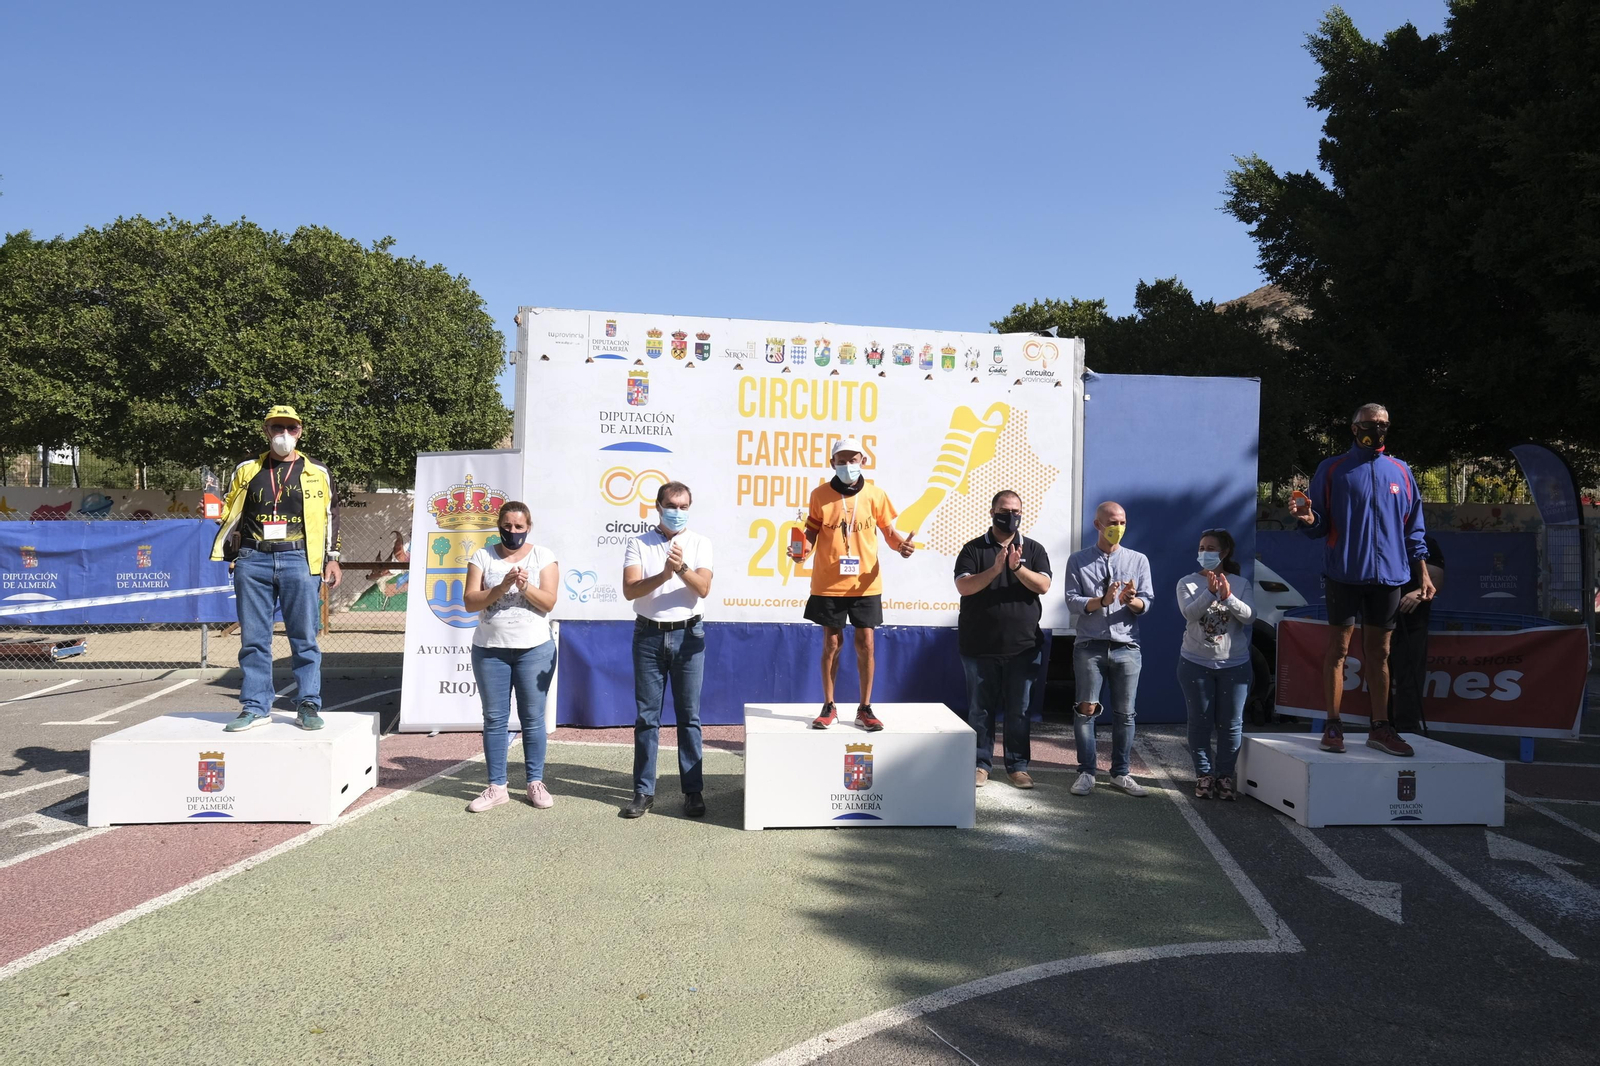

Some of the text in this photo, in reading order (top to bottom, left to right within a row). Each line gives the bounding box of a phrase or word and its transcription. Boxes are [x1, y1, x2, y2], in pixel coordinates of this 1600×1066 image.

[592, 338, 630, 346] DIPUTACIÓN
[1025, 368, 1055, 377] circuitos
[737, 375, 879, 423] CIRCUITO
[599, 410, 676, 424] DIPUTACIÓN
[600, 424, 674, 436] DE ALMERÍA
[844, 565, 856, 573] 233
[2, 571, 58, 581] DIPUTACIÓN
[116, 570, 171, 581] DIPUTACIÓN
[1479, 574, 1518, 582] DIPUTACIÓN
[3, 579, 57, 589] DE ALMERÍA
[117, 579, 170, 589] DE ALMERÍA
[1490, 581, 1517, 589] ALMERÍA
[593, 586, 617, 594] JUEGA
[1457, 655, 1469, 666] &
[1473, 654, 1525, 666] SHOES
[456, 663, 473, 672] DE
[438, 680, 480, 697] RIOJ
[186, 795, 236, 803] DIPUTACIÓN
[830, 793, 884, 802] DIPUTACIÓN
[199, 803, 234, 811] ALMERÍA
[845, 801, 882, 810] ALMERÍA
